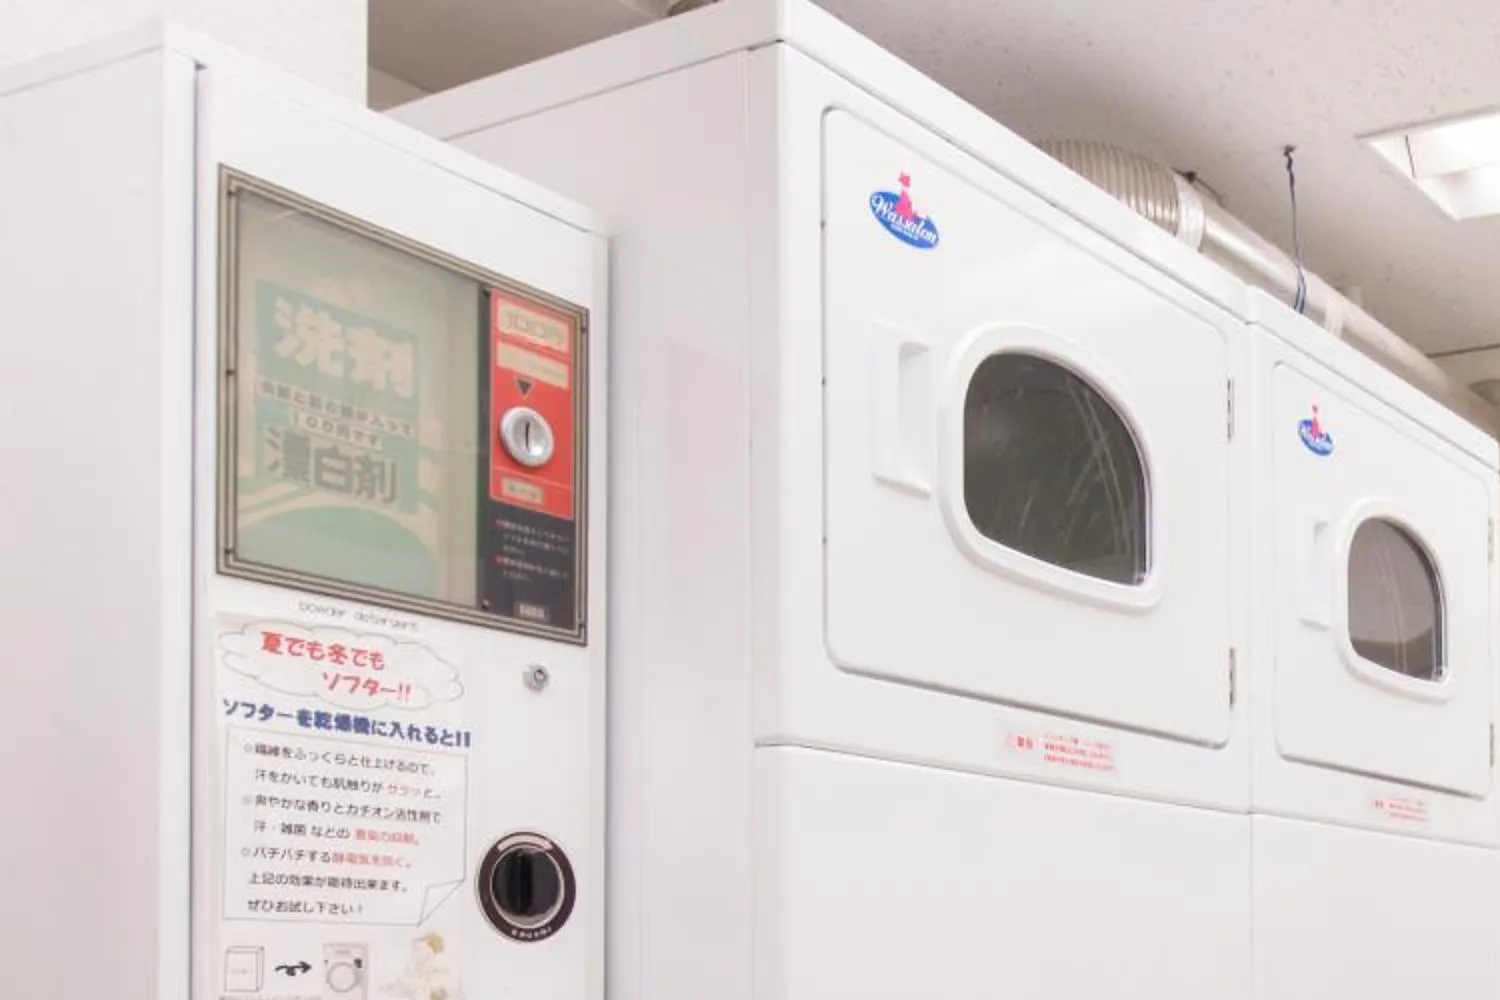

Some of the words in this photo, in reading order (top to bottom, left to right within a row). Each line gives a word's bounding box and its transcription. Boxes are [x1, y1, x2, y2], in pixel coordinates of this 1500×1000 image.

[272, 297, 415, 398] 洗剤
[265, 424, 398, 505] 漂白剤
[261, 631, 385, 671] 夏でも冬でも
